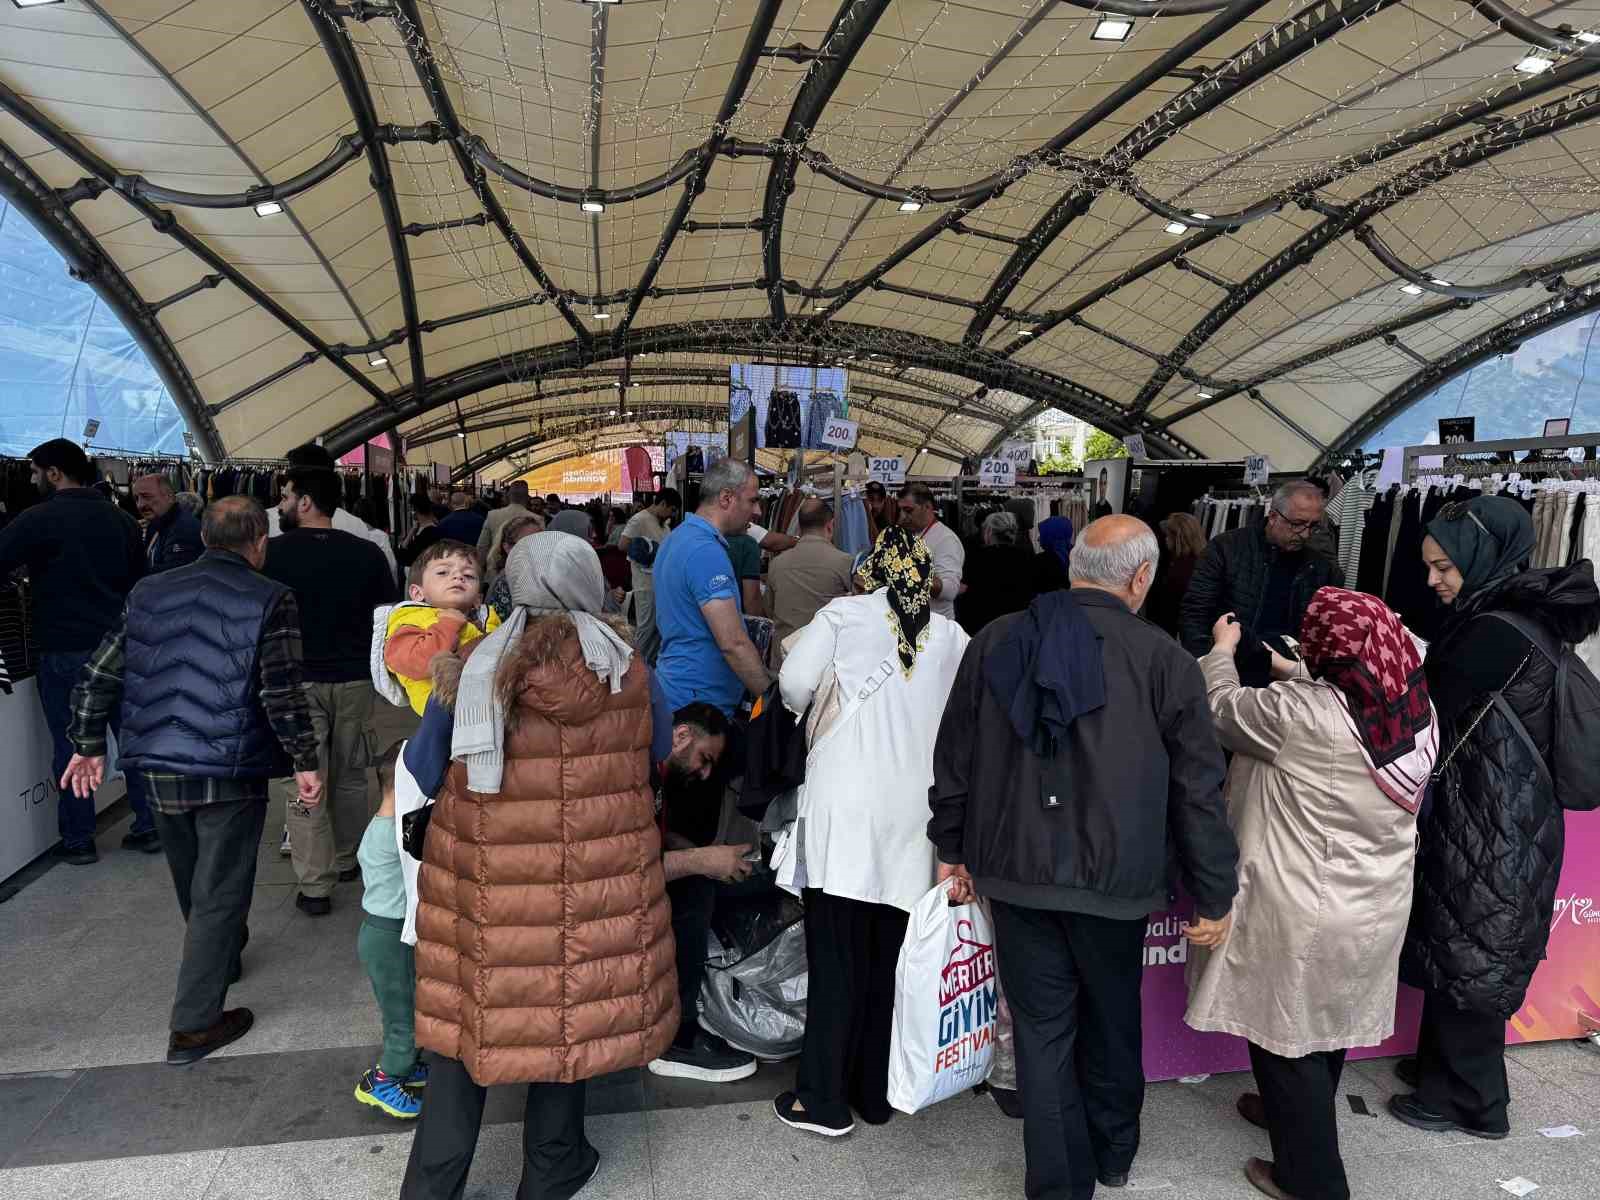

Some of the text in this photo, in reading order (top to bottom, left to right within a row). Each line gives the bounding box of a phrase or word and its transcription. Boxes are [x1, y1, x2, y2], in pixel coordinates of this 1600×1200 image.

[827, 425, 849, 441] 200
[873, 459, 898, 471] 200
[984, 461, 1009, 474] 200
[881, 472, 894, 482] TL
[940, 950, 994, 1002] MERTER
